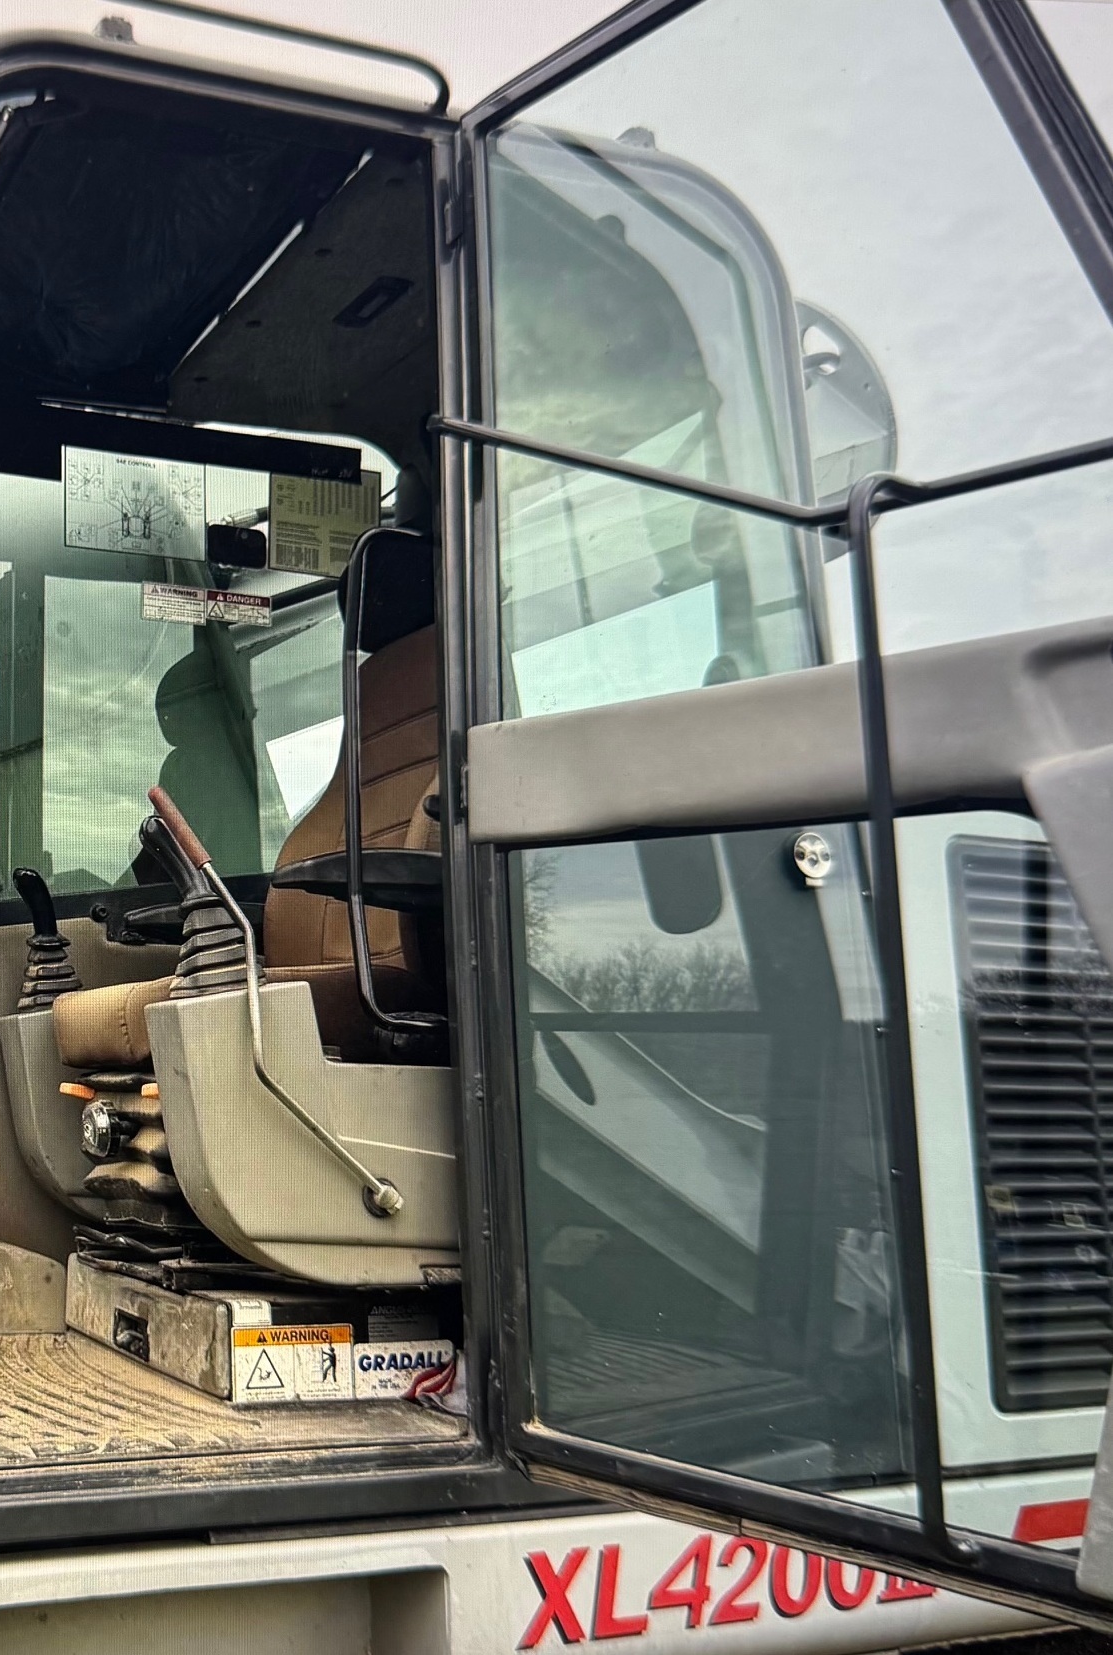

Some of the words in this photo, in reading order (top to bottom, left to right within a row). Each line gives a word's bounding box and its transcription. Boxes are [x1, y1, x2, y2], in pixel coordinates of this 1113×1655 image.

[159, 586, 198, 598] WARNING
[226, 594, 262, 606] DANGER
[270, 1329, 329, 1342] WARNING
[357, 1350, 444, 1372] GRADALL
